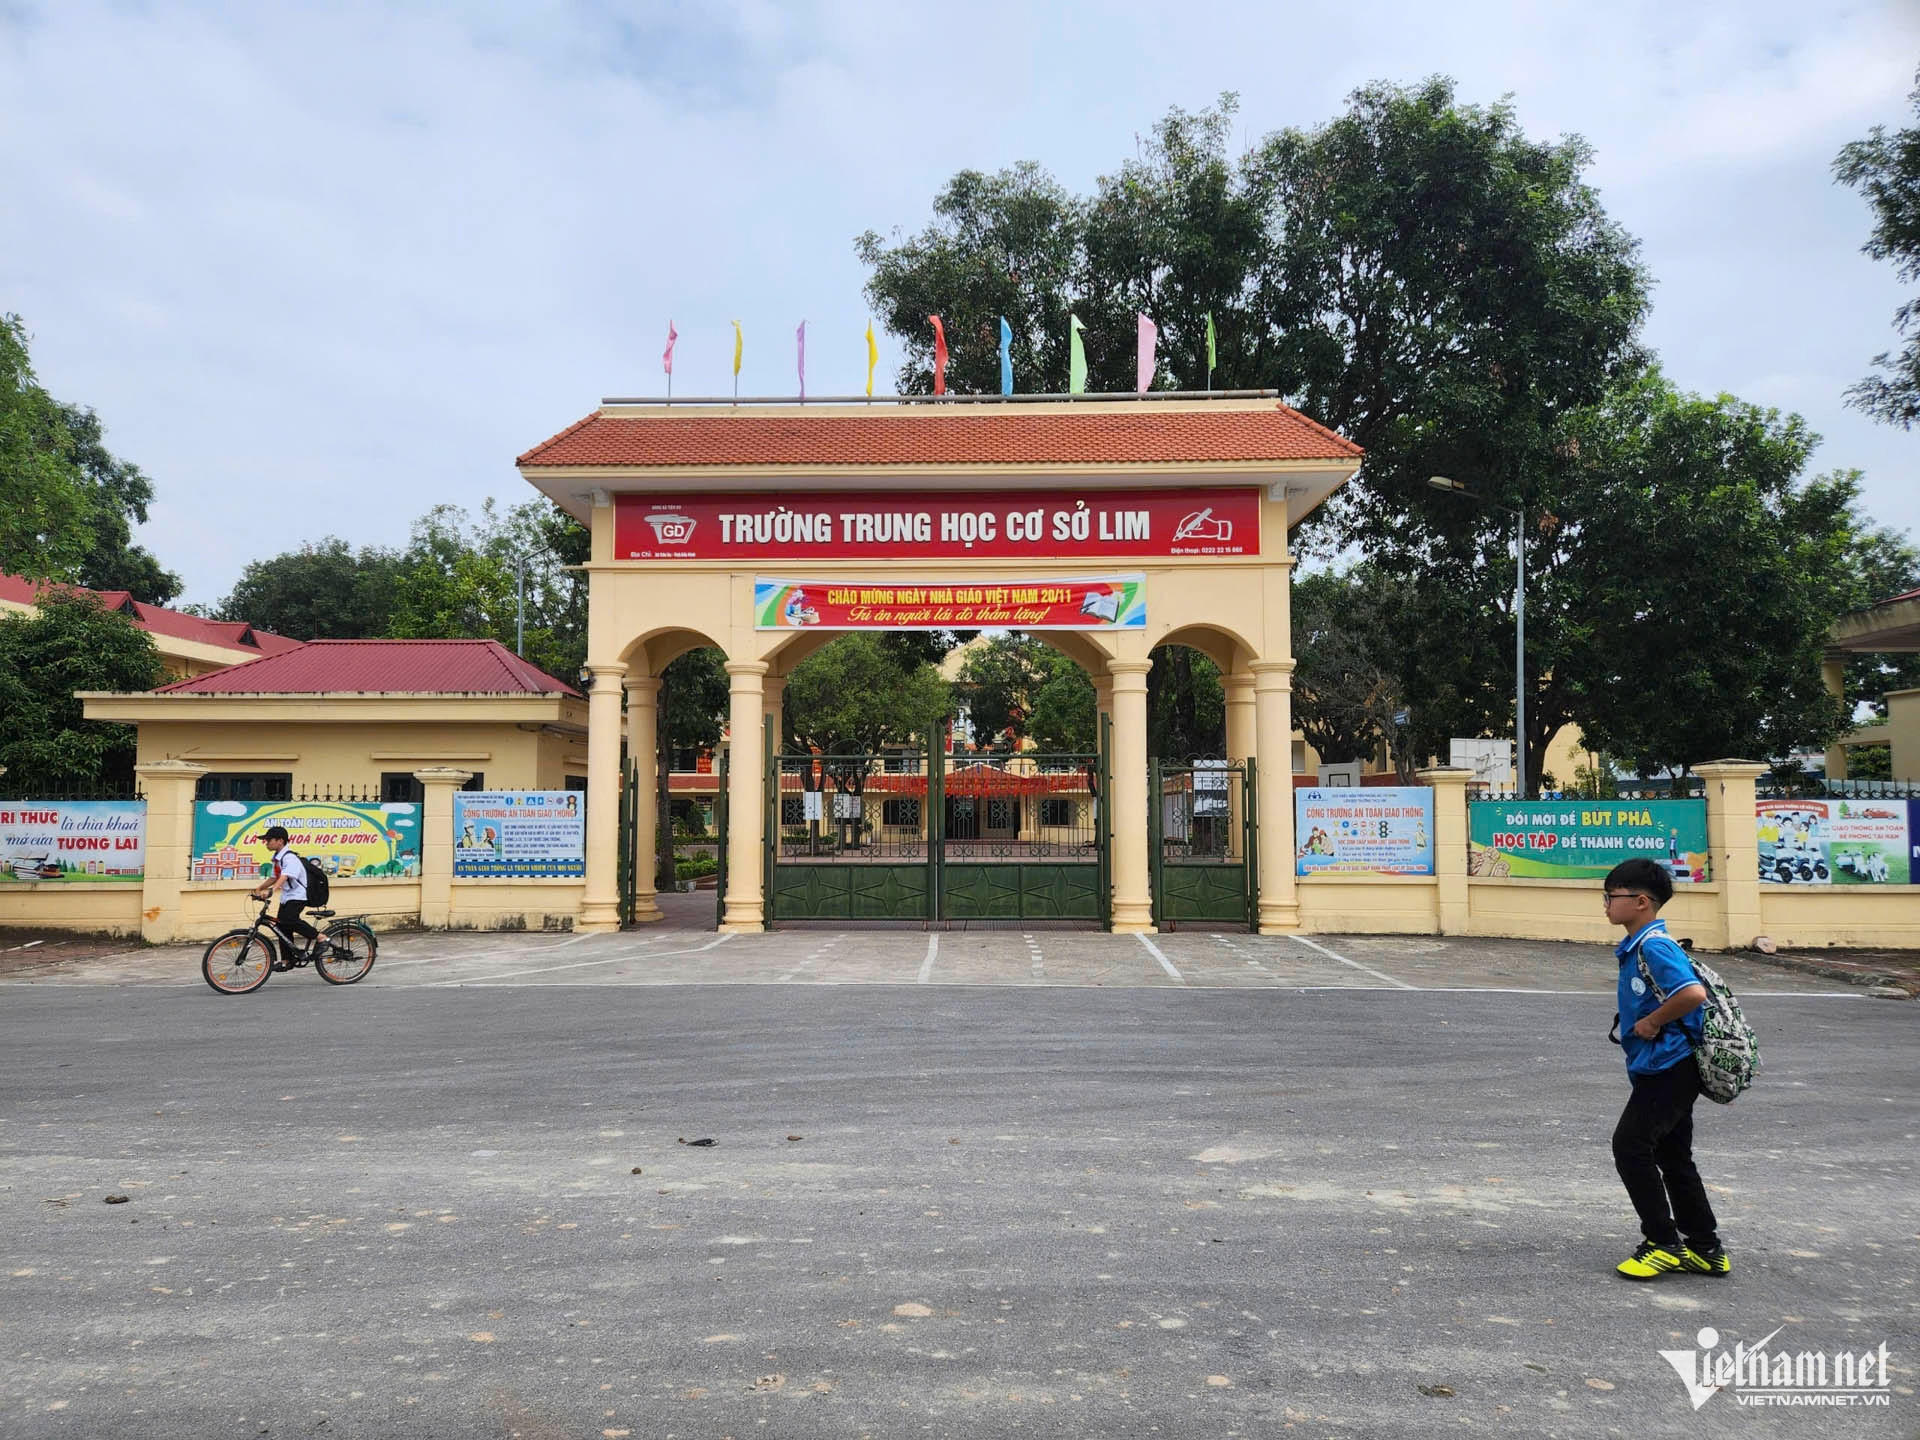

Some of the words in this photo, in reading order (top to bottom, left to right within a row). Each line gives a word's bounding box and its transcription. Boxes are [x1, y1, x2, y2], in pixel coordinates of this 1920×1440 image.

[662, 525, 685, 538] GD
[718, 506, 832, 543] TRƯỜNG
[840, 512, 931, 543] TRUNG
[941, 511, 996, 548] HỌC
[1006, 508, 1044, 542] CƠ
[1052, 500, 1090, 541] SỞ
[1099, 511, 1150, 541] LIM
[828, 588, 857, 604] CHÀO
[861, 588, 894, 604] MỪNG
[897, 588, 927, 604] NGÀY
[929, 588, 953, 604] NHÀ
[956, 588, 982, 604] GIÁO
[985, 587, 1009, 606] VIỆT
[1012, 589, 1038, 603] NAM
[1041, 588, 1071, 603] 20/11
[893, 608, 931, 625] người
[934, 606, 953, 621] lái
[955, 606, 974, 621] đò
[975, 605, 1011, 621] thầm
[0, 811, 15, 824] RI
[20, 808, 58, 824] THỨC
[61, 816, 74, 830] là
[77, 816, 104, 830] chìa
[1385, 807, 1400, 817] GIAO
[1506, 810, 1528, 825] ĐỔI
[1560, 810, 1576, 825] ĐỂ
[1581, 809, 1613, 826] BỨT
[1617, 808, 1653, 826] PHÁ
[264, 818, 278, 828] AN
[279, 816, 304, 828] TOÀN
[306, 818, 328, 828] GIAO
[330, 816, 361, 828] THÔNG
[115, 837, 138, 850] LAI
[315, 833, 337, 847] HỌC
[340, 832, 378, 845] ĐƯỜNG
[1493, 833, 1525, 852] HỌC
[1529, 831, 1558, 852] TẬP
[1561, 833, 1577, 848] ĐỂ
[1580, 834, 1623, 848] THÀNH
[1627, 834, 1665, 849] CÔNG
